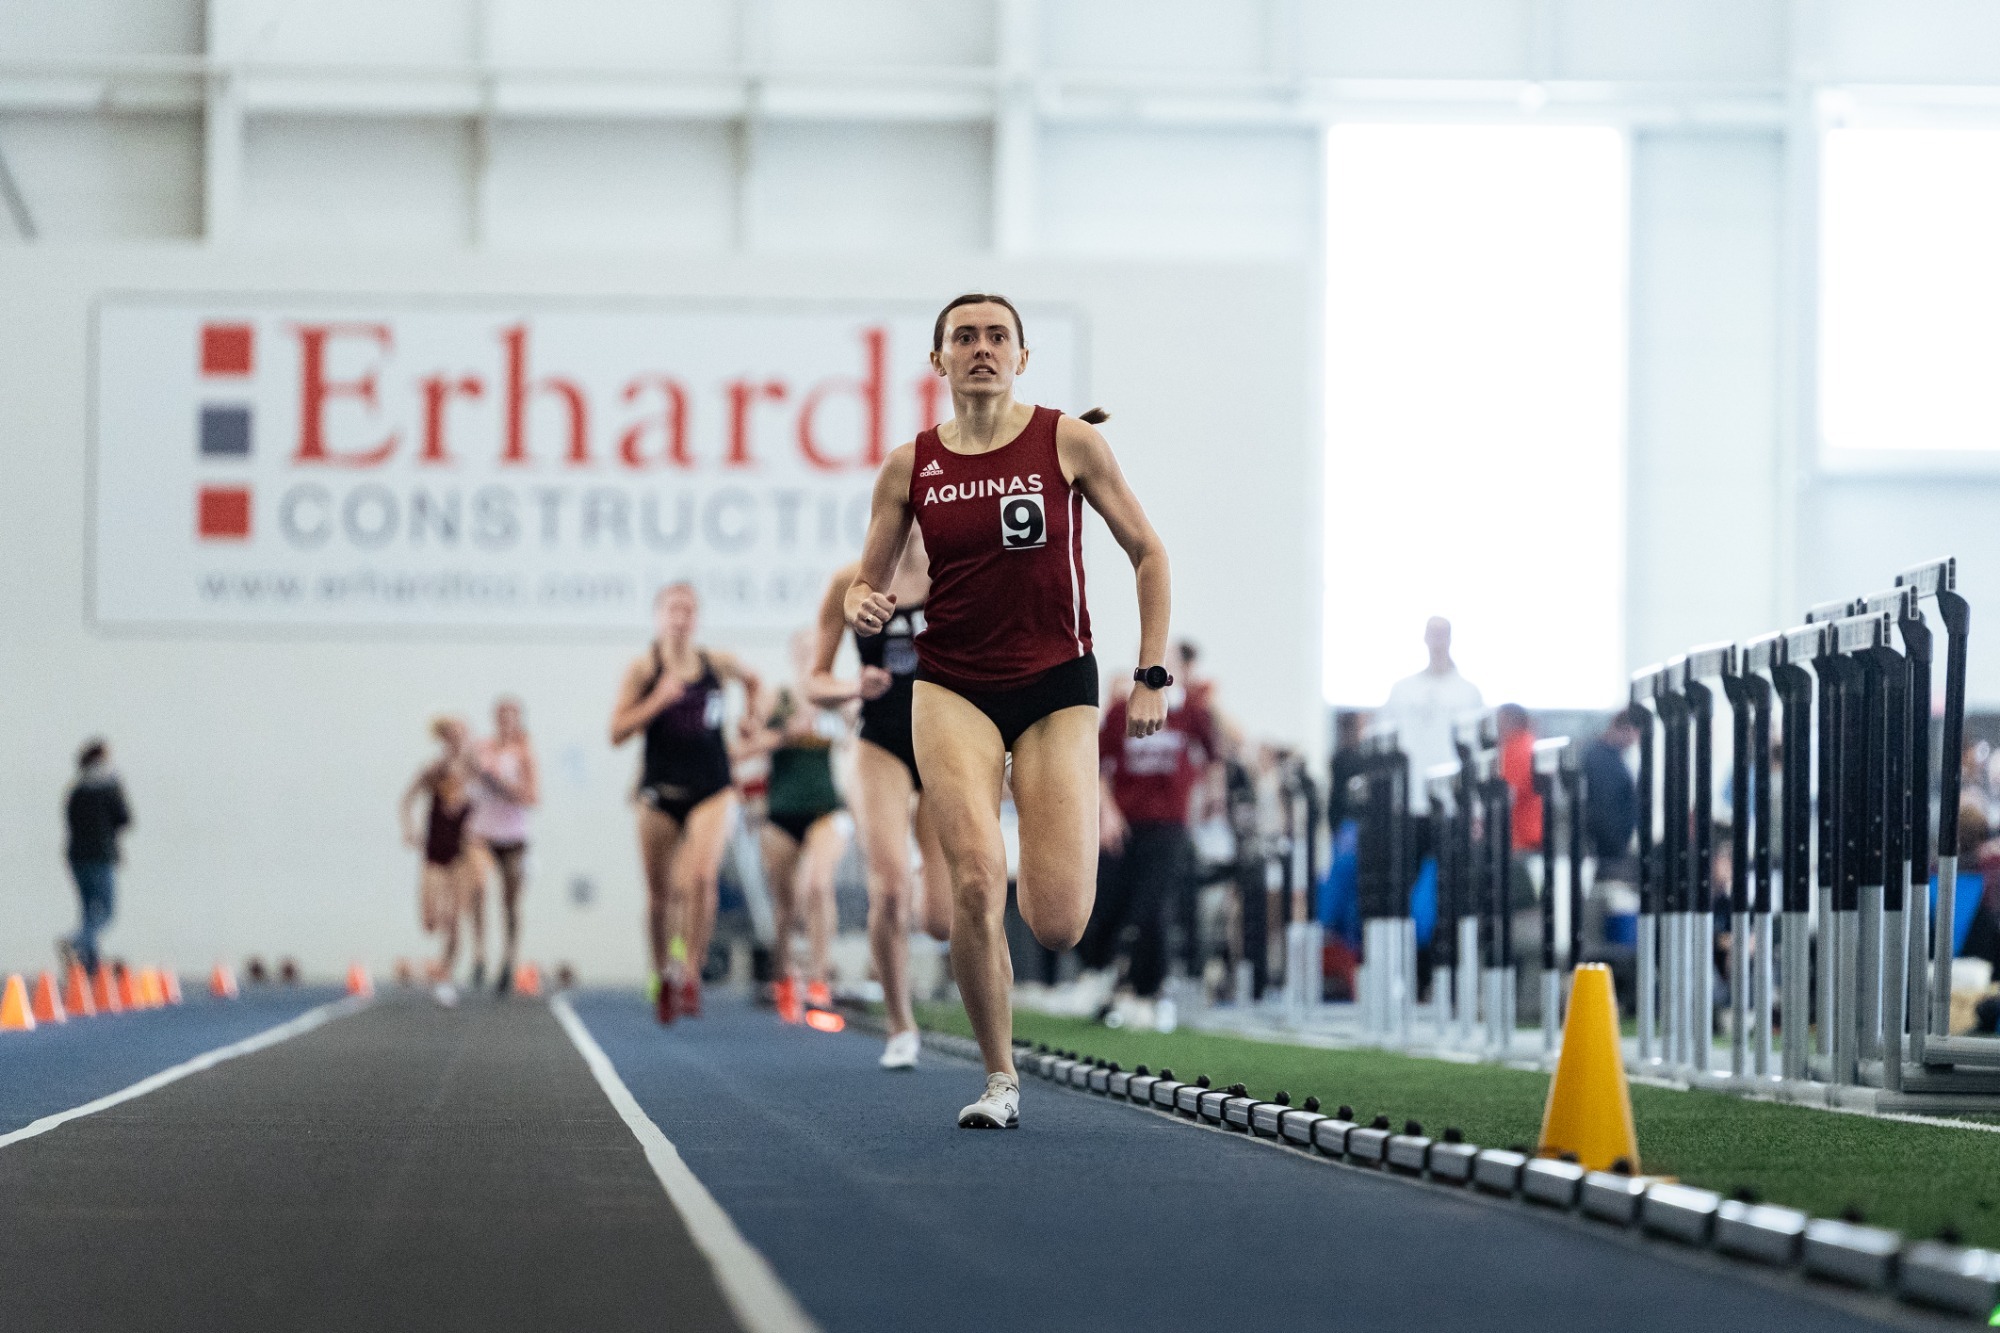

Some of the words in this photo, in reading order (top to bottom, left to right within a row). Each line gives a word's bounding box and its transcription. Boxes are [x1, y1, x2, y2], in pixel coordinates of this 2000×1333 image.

[919, 469, 944, 478] adidas
[923, 473, 1044, 506] AQUINAS
[1002, 498, 1044, 546] 9
